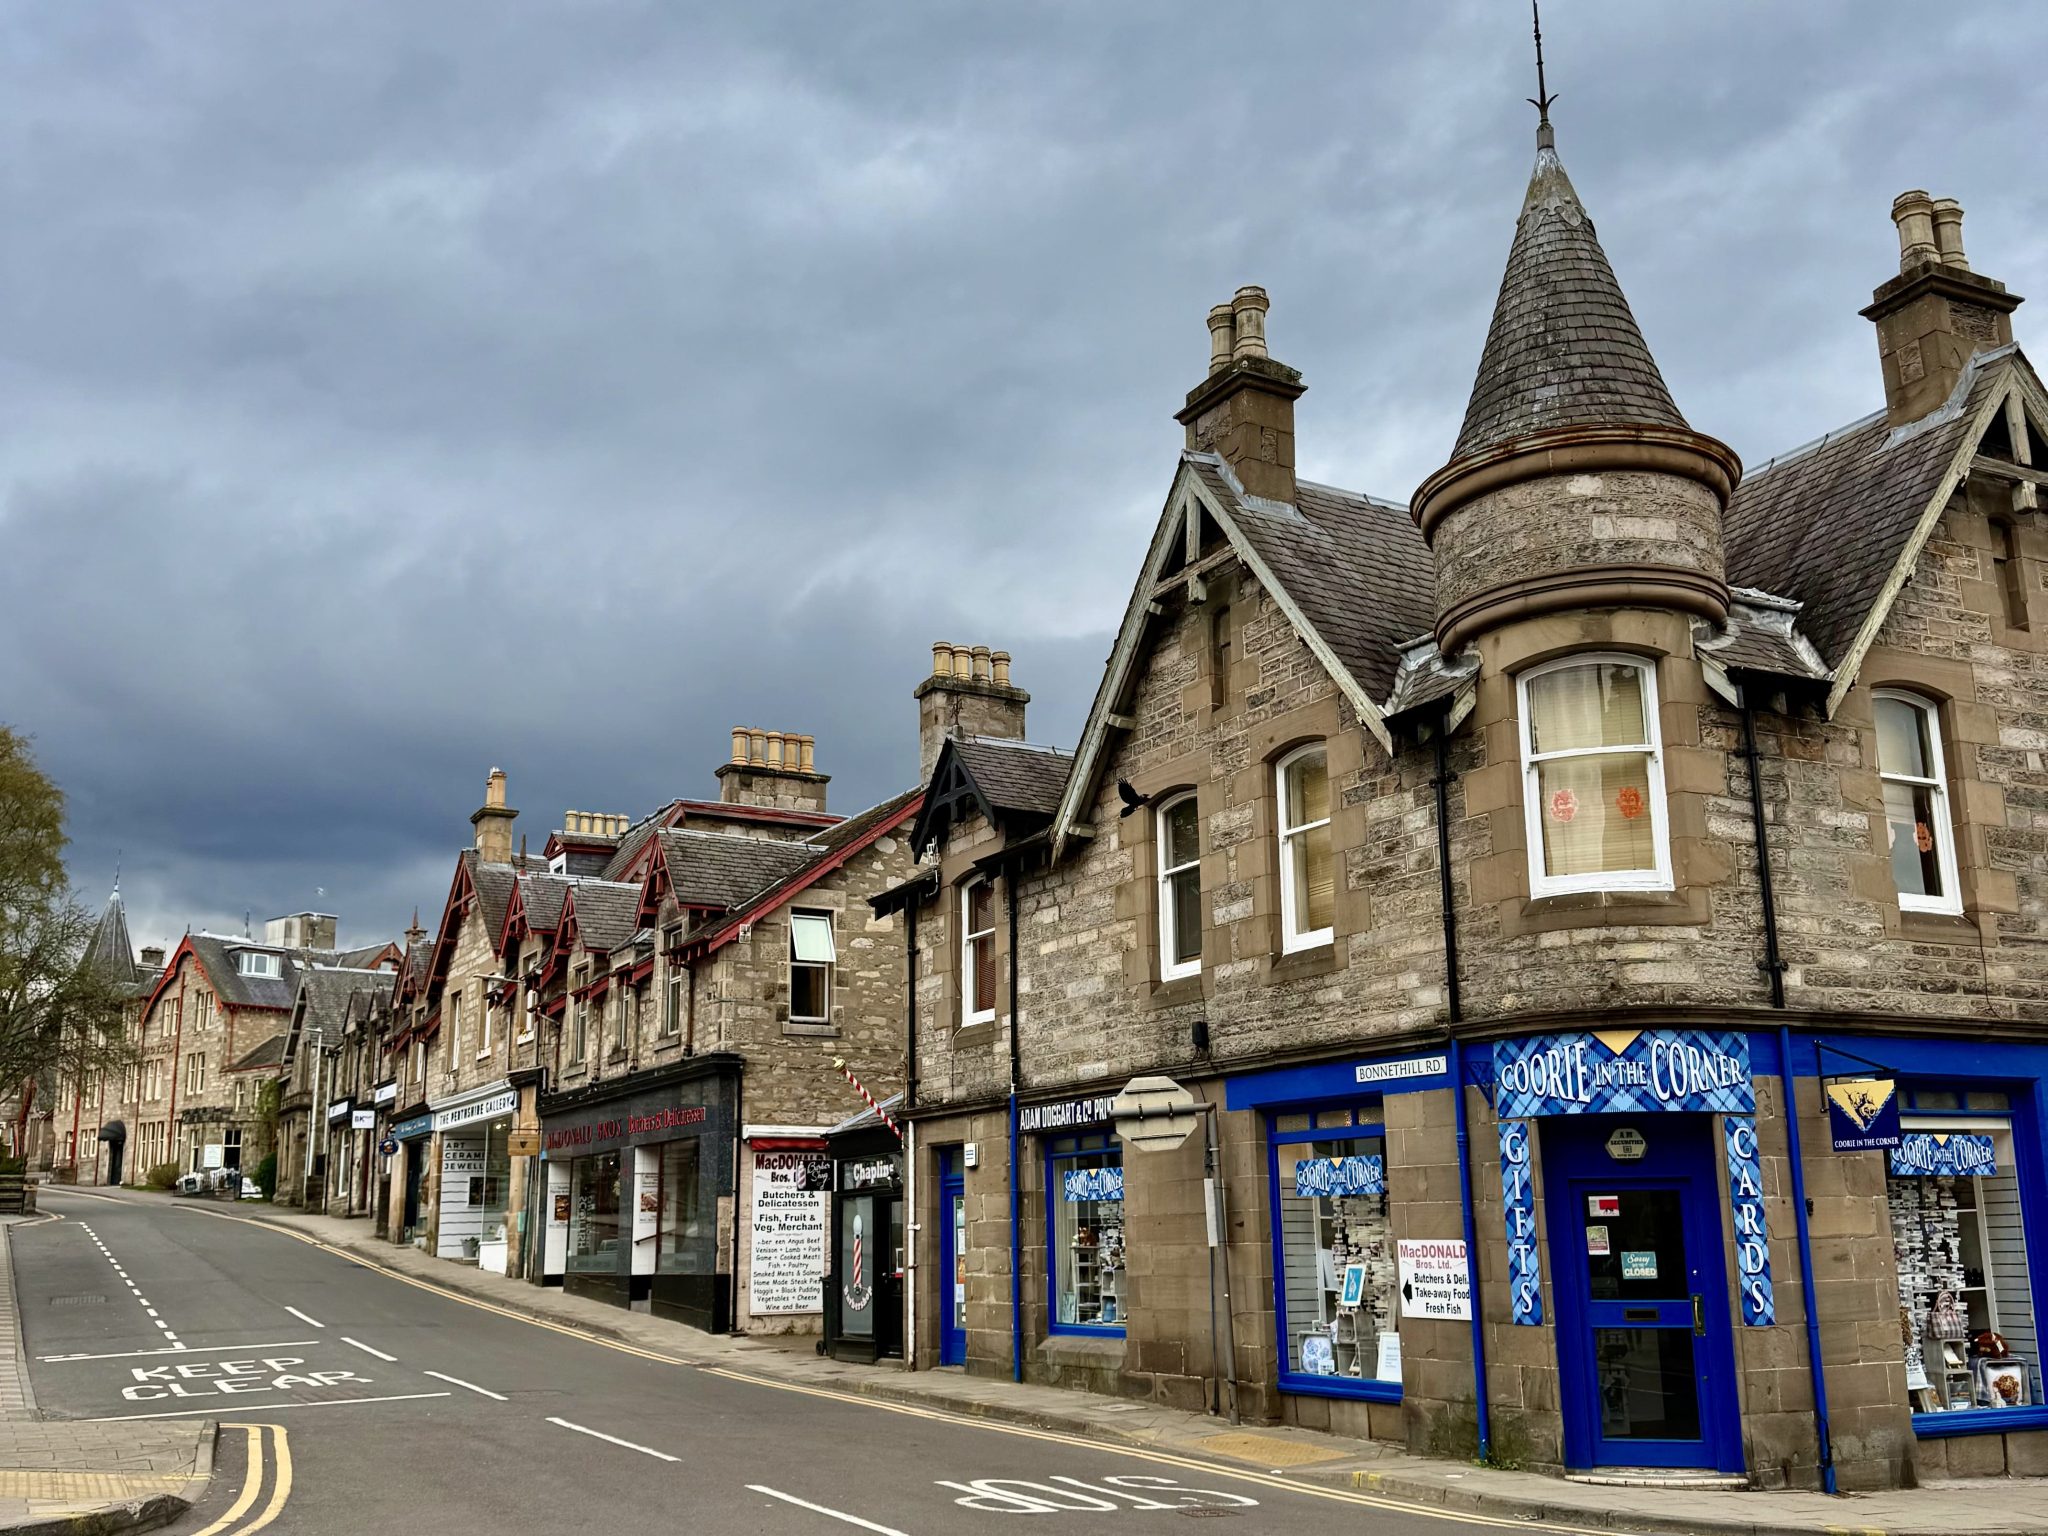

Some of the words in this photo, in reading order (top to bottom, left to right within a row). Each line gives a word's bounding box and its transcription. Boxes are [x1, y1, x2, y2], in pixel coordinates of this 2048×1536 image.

[1360, 1064, 1423, 1080] BONNETHILL
[1426, 1060, 1440, 1072] RD
[1502, 1040, 1591, 1102] COORIE
[1595, 1062, 1612, 1086] IN
[1616, 1062, 1647, 1085] THE
[1652, 1039, 1745, 1101] CORNER
[440, 1113, 449, 1125] THE
[451, 1104, 483, 1122] PERTHSHIRE
[486, 1096, 510, 1113] GALLERY
[1020, 1107, 1040, 1130] ADAM
[1042, 1102, 1075, 1128] DOGGART
[1076, 1104, 1082, 1123] &
[1834, 1140, 1856, 1148] COORIE
[1857, 1139, 1863, 1147] IN
[1876, 1137, 1899, 1146] CORNER
[1934, 1150, 1940, 1161] IN
[1940, 1150, 1953, 1162] THE
[1954, 1138, 1992, 1170] CORNER
[771, 1172, 790, 1182] Bros.
[854, 1160, 894, 1184] Chaplins
[1100, 1168, 1122, 1195] CORNER
[1298, 1161, 1329, 1192] COORIE
[1347, 1160, 1380, 1190] CORNER
[760, 1214, 781, 1222] Fish,
[1505, 1133, 1533, 1314] GIFTS
[1733, 1126, 1764, 1314] CARDS
[754, 1224, 775, 1233] Veg.
[1400, 1244, 1466, 1258] MacDONALD
[1627, 1254, 1650, 1265] Sorry
[1416, 1260, 1434, 1269] Bros.
[1438, 1260, 1452, 1269] Ltd.
[1624, 1268, 1656, 1277] CLOSED
[1414, 1273, 1444, 1284] Butchers
[1446, 1274, 1451, 1284] &
[1454, 1274, 1469, 1284] Deli.
[798, 1286, 820, 1294] Pudding
[1415, 1287, 1451, 1301] Take-away
[1454, 1289, 1470, 1299] Food
[1426, 1303, 1444, 1313] Fresh
[1447, 1304, 1461, 1314] Fish
[131, 1357, 304, 1381] KEEP
[121, 1371, 374, 1400] CLEAR
[934, 1476, 1259, 1513] STOP
